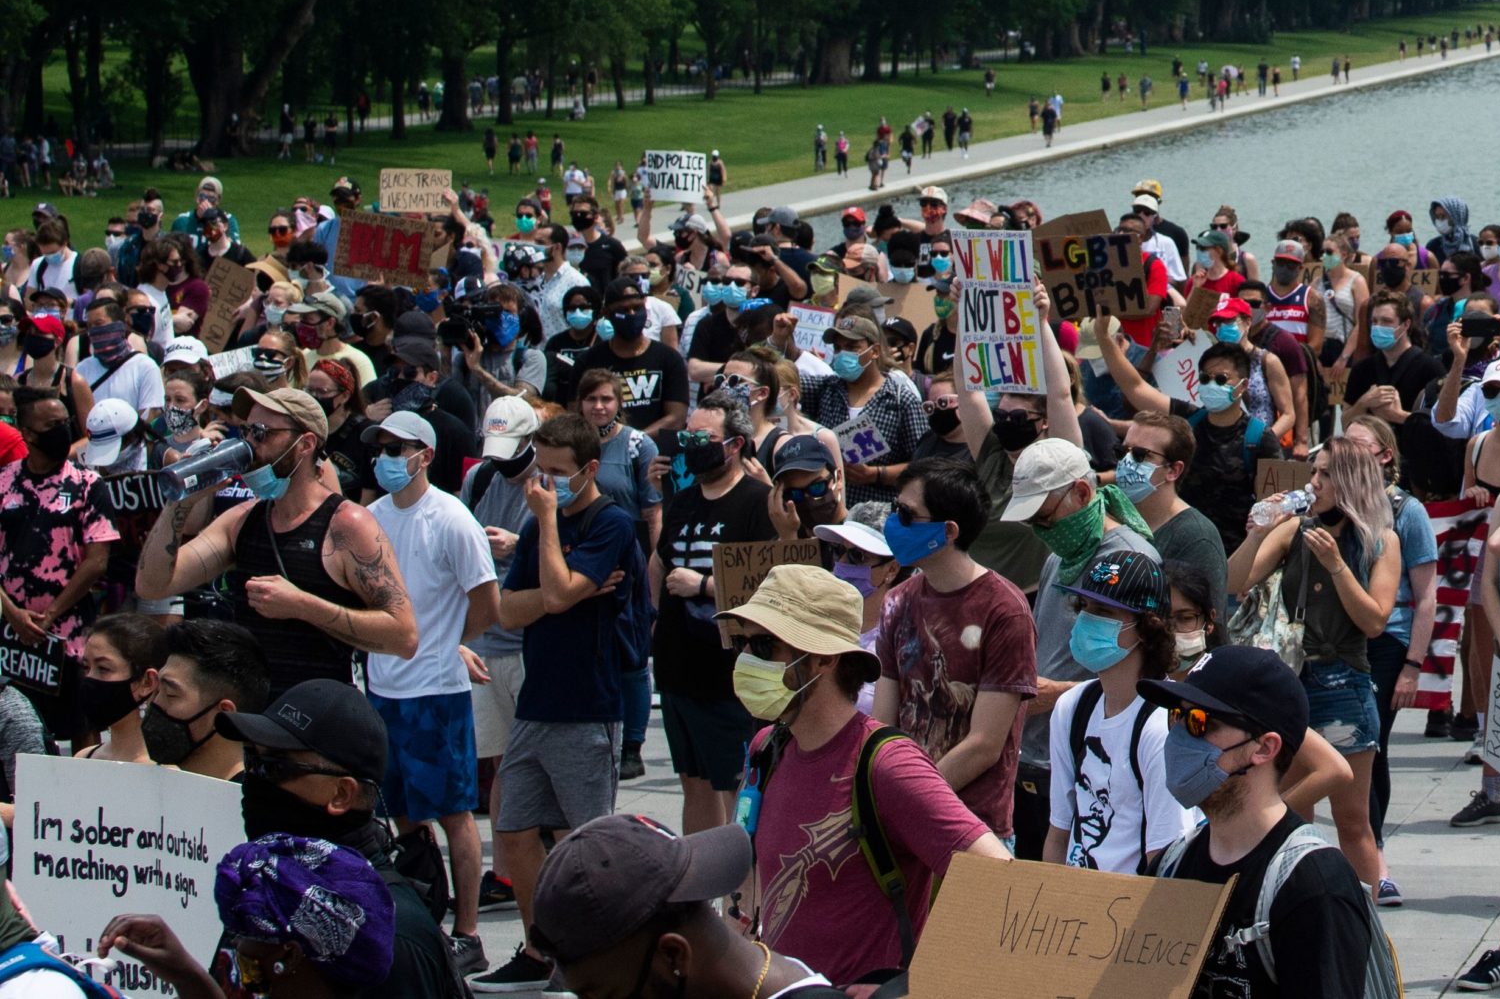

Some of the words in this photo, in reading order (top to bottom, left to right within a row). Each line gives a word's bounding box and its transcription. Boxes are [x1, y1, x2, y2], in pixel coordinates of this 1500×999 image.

[381, 174, 413, 189] BLACK
[416, 172, 450, 188] TRANS
[648, 153, 664, 169] END
[666, 153, 704, 170] POLICE
[381, 192, 408, 210] LIVES
[348, 222, 424, 275] BLM
[953, 238, 987, 281] WE
[986, 238, 1031, 283] WILL
[1040, 234, 1131, 272] LGBT
[1074, 269, 1114, 290] FOR
[1376, 271, 1431, 285] BCK
[964, 287, 999, 333] NOT
[1002, 291, 1035, 335] BE
[965, 341, 1038, 387] SILENT
[723, 545, 753, 570] SAY
[758, 545, 776, 566] IT
[783, 544, 817, 562] LOUD
[0, 647, 58, 686] REATHE
[70, 806, 134, 848] sober
[137, 816, 164, 850] and
[166, 827, 209, 863] outside
[34, 850, 128, 898] marching
[134, 858, 163, 886] with
[165, 872, 172, 890] a
[174, 872, 198, 908] sign.
[1000, 882, 1089, 957] WHITE
[1089, 897, 1199, 967] SILENCE
